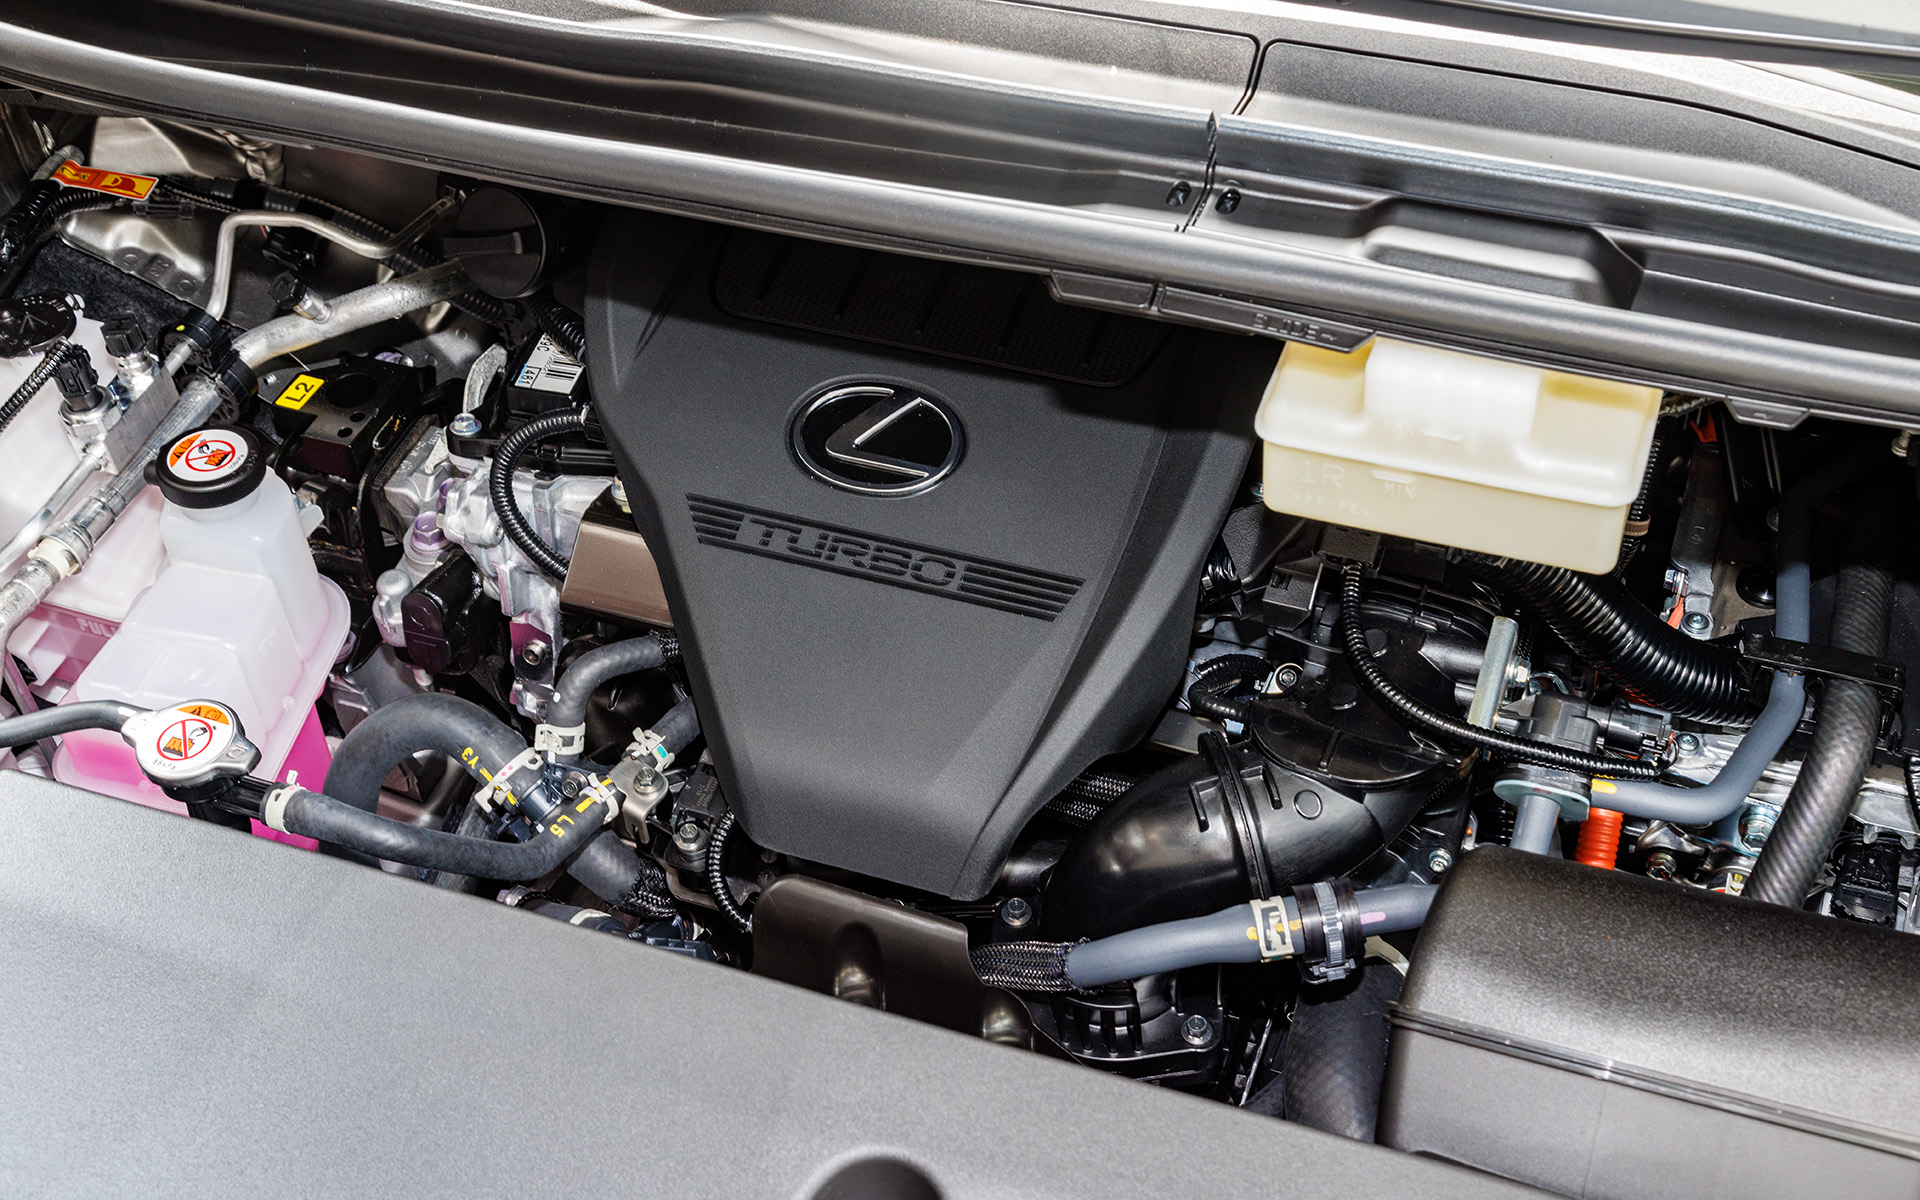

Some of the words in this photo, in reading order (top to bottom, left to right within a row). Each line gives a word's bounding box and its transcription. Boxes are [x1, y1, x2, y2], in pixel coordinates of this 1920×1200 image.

[1253, 313, 1319, 340] SLIDE
[285, 382, 314, 402] L2
[1299, 459, 1346, 489] 1R
[1384, 481, 1416, 501] MIN
[750, 517, 956, 586] TURBO
[549, 815, 575, 838] L5
